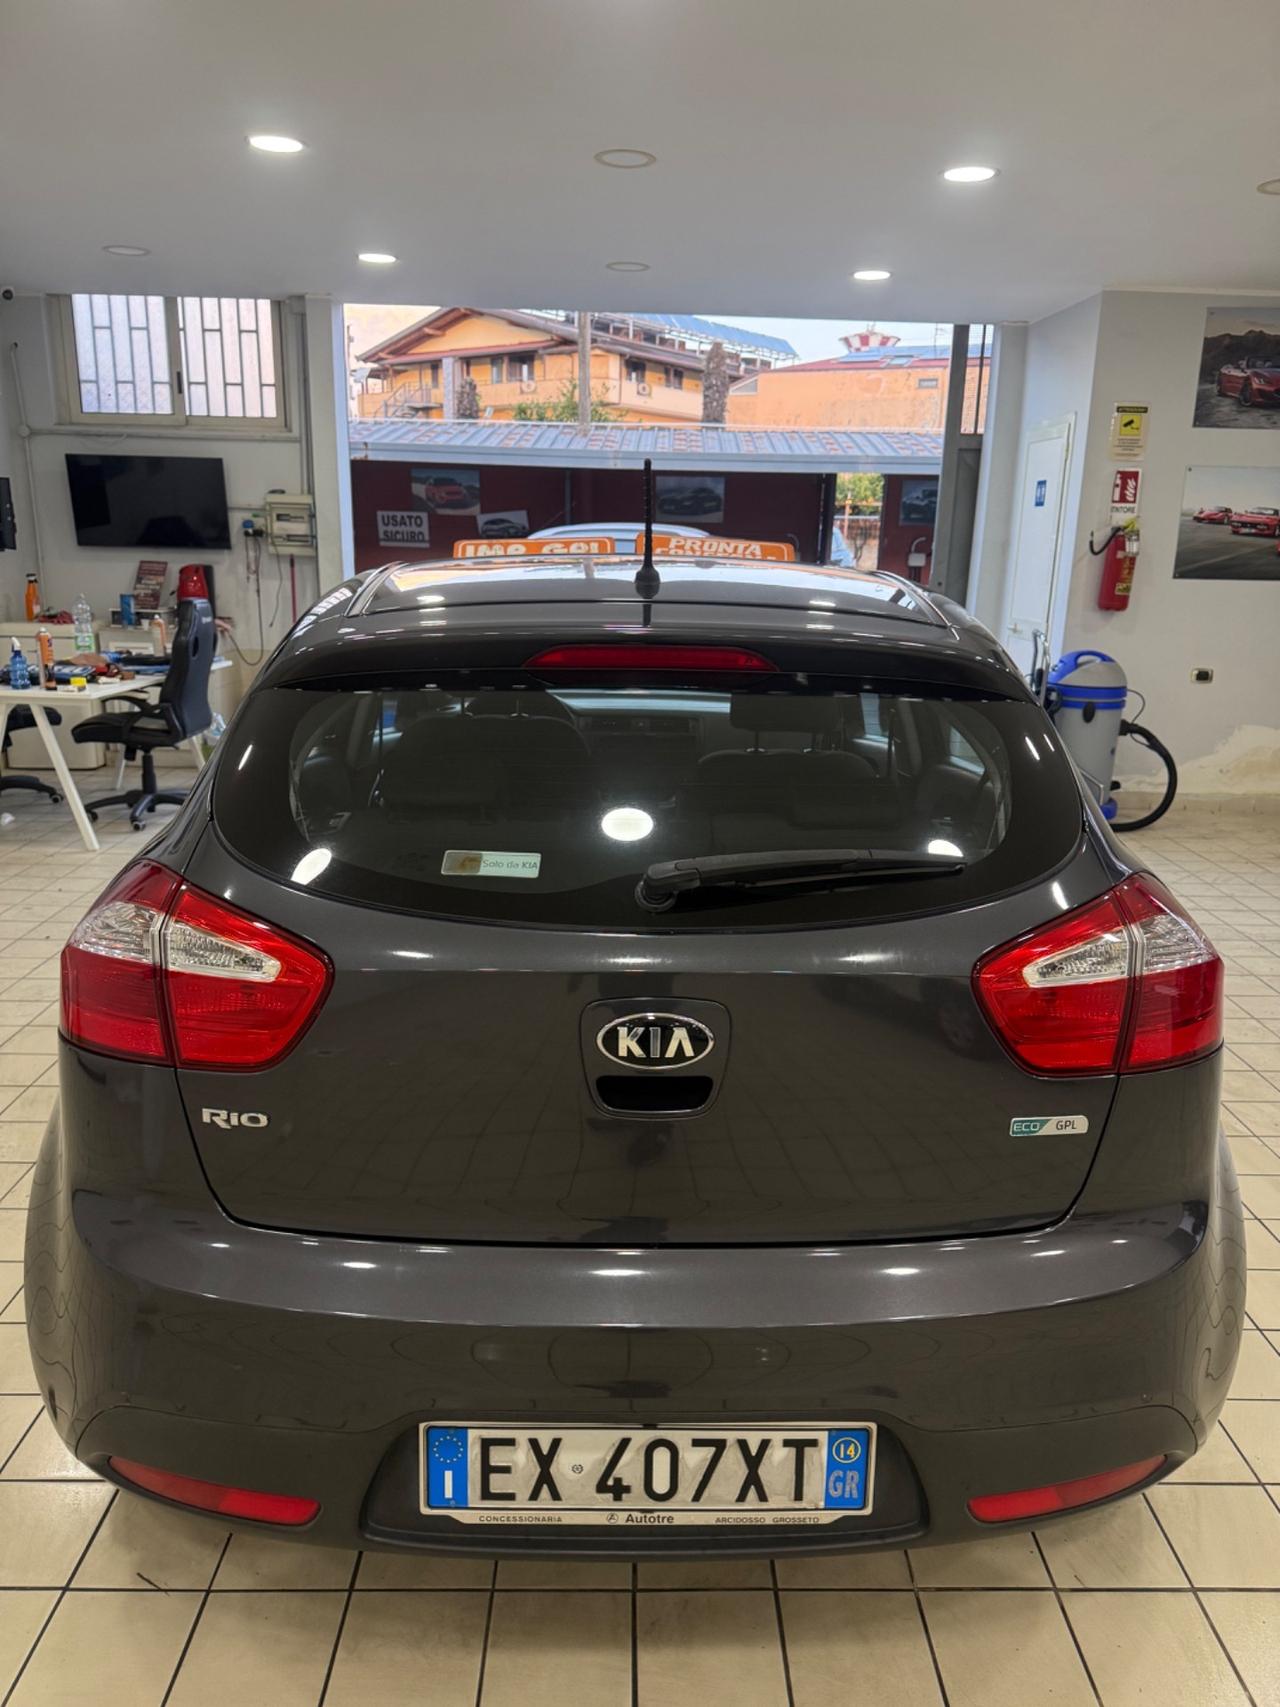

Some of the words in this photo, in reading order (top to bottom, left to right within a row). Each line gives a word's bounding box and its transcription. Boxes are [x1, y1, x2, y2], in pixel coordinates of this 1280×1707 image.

[381, 515, 424, 528] USATO
[383, 530, 426, 543] SICURO
[668, 537, 762, 555] PRONTA
[482, 859, 504, 869] Solo
[506, 861, 519, 870] da
[521, 861, 538, 870] KIA
[617, 1026, 695, 1058] KIA
[1013, 1122, 1040, 1132] ECO
[1055, 1119, 1077, 1131] GPL
[840, 1443, 856, 1458] 14
[480, 1437, 562, 1502] EX
[595, 1437, 819, 1503] 407XT
[828, 1470, 860, 1499] GR
[478, 1515, 563, 1523] CONCESSIONARIA
[625, 1513, 675, 1525] Autotre
[714, 1516, 766, 1524] ARCIDOSSO
[771, 1516, 820, 1524] GROSSETO
